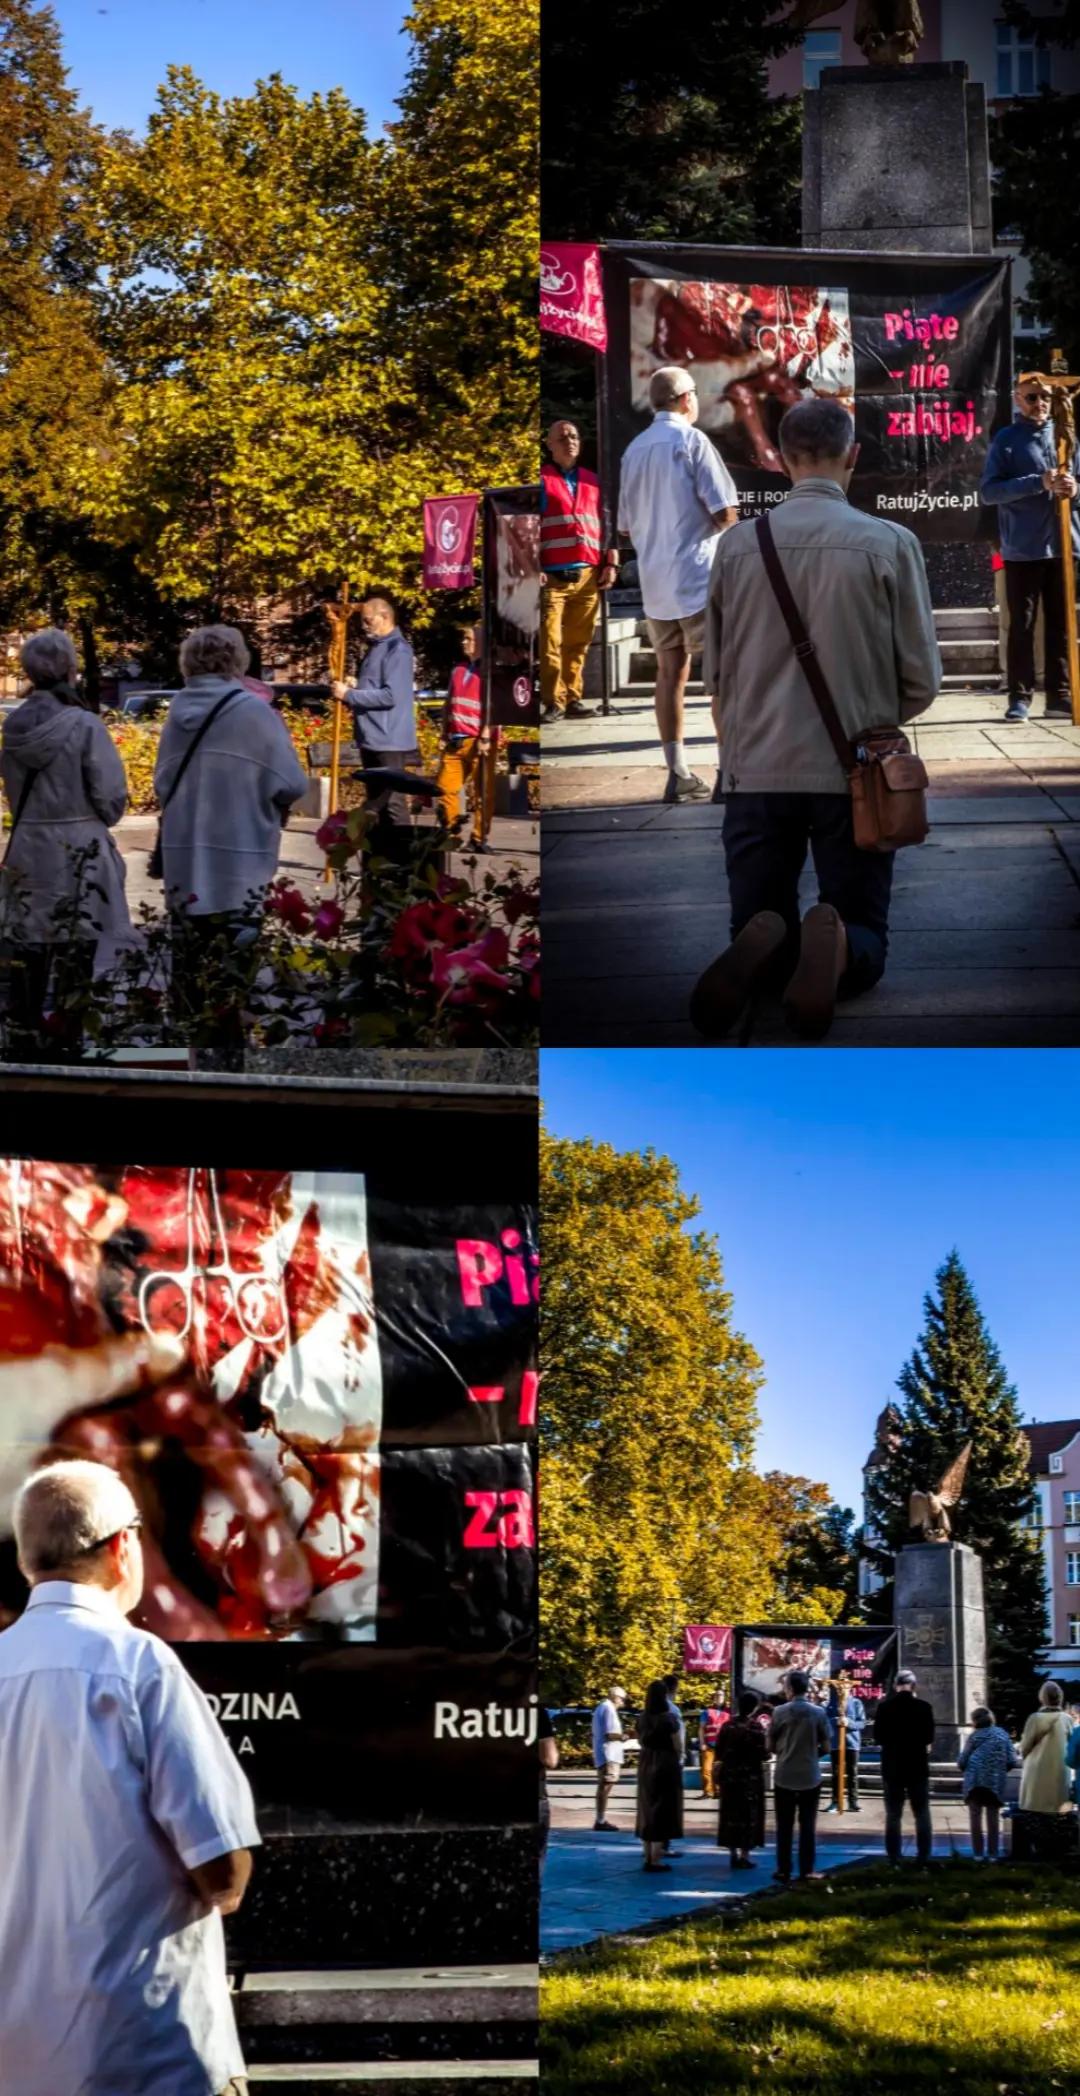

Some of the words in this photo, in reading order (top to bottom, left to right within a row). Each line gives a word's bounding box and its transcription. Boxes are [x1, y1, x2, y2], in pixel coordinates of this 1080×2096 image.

[884, 309, 959, 349] Piąte
[909, 354, 950, 389] nie
[887, 401, 982, 442] zabijaj.
[876, 489, 979, 513] RatujŻycie.pl
[456, 1227, 539, 1306] Pi
[463, 1488, 539, 1549] za
[434, 1694, 539, 1746] Ratuj
